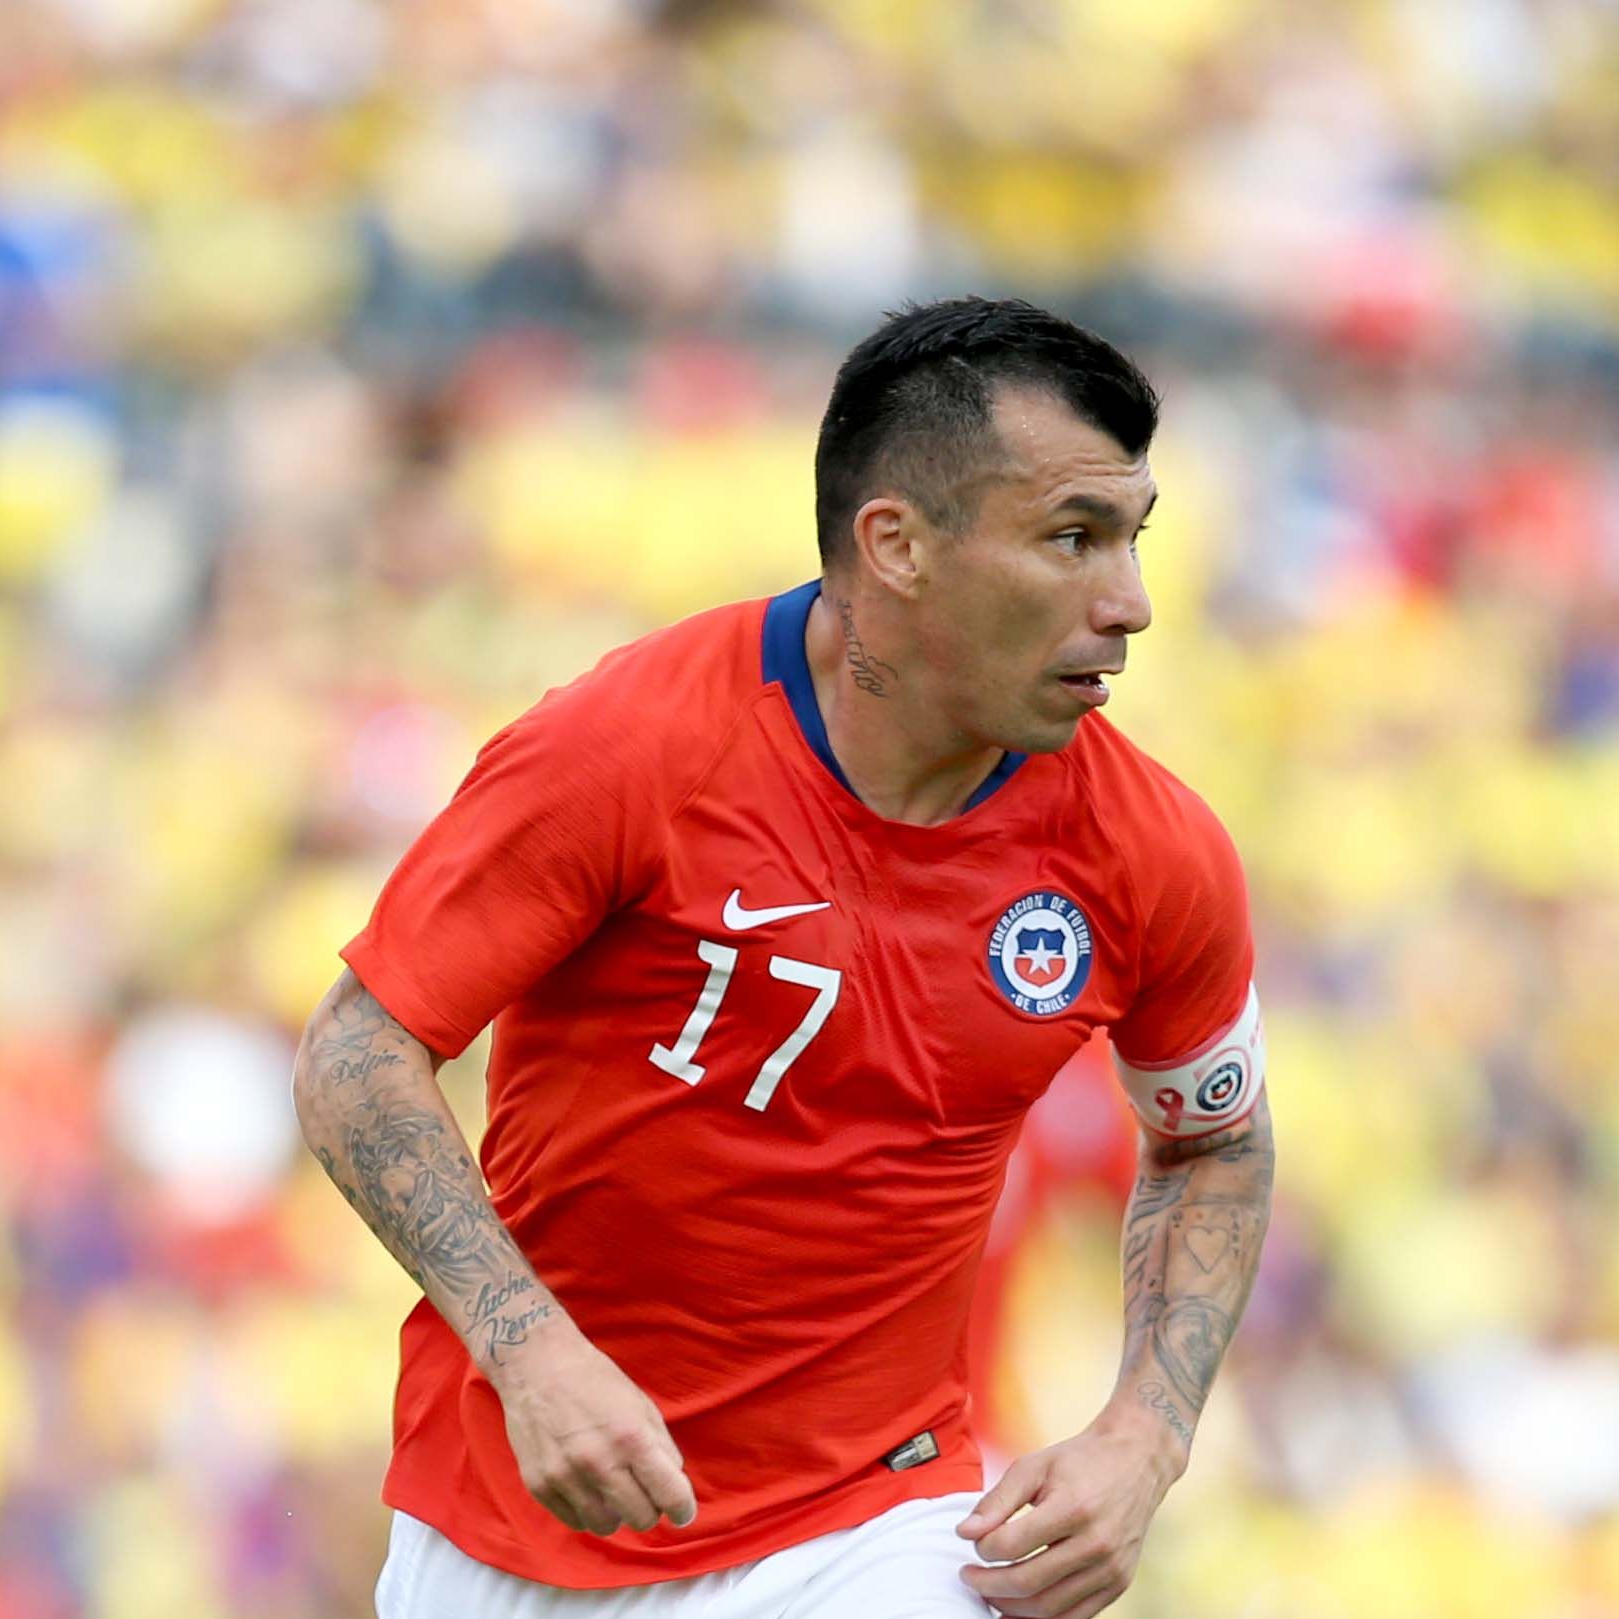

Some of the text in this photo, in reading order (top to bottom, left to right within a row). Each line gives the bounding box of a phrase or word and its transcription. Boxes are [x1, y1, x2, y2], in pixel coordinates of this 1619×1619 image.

[989, 894, 1043, 956] FEDERACION
[1050, 895, 1068, 913] DE
[648, 939, 843, 1112] 17
[1015, 994, 1067, 1014] DE CHILE
